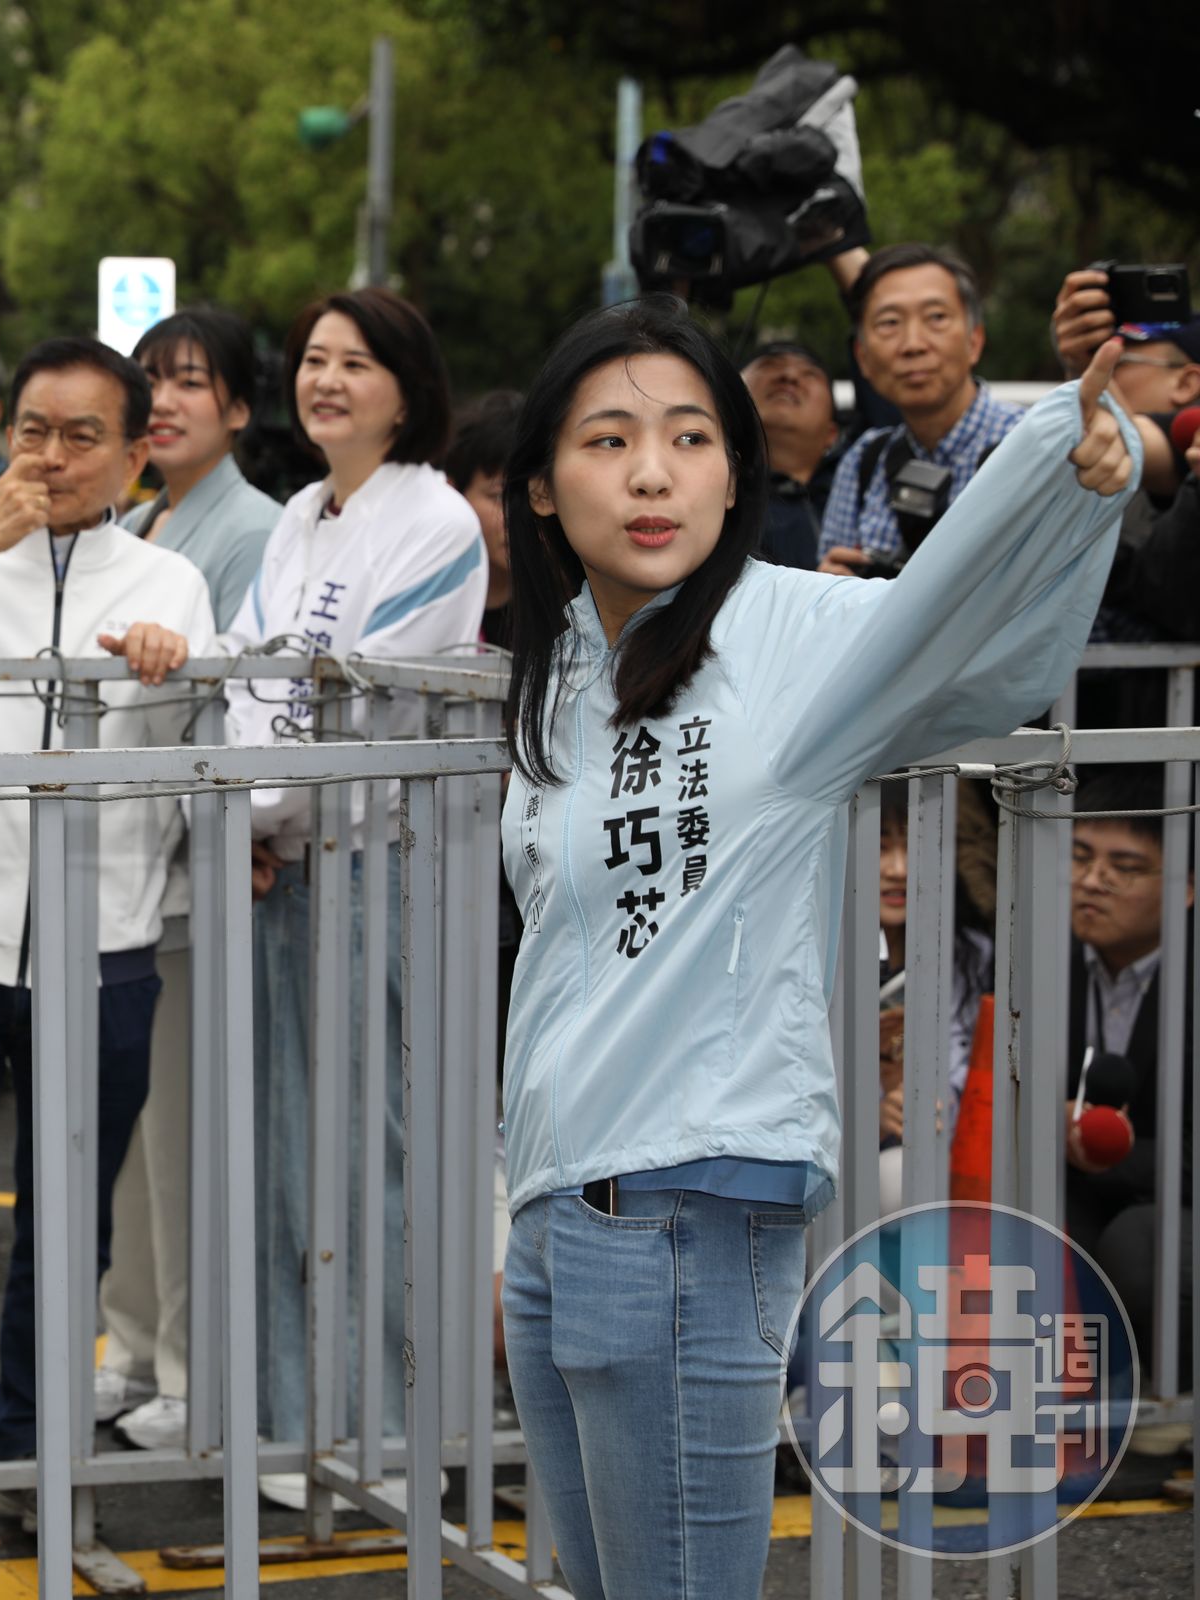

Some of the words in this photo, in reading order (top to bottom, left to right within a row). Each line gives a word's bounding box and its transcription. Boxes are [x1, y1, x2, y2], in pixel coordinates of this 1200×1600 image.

[603, 726, 666, 959] 徐巧芯
[676, 716, 713, 898] 立法委員
